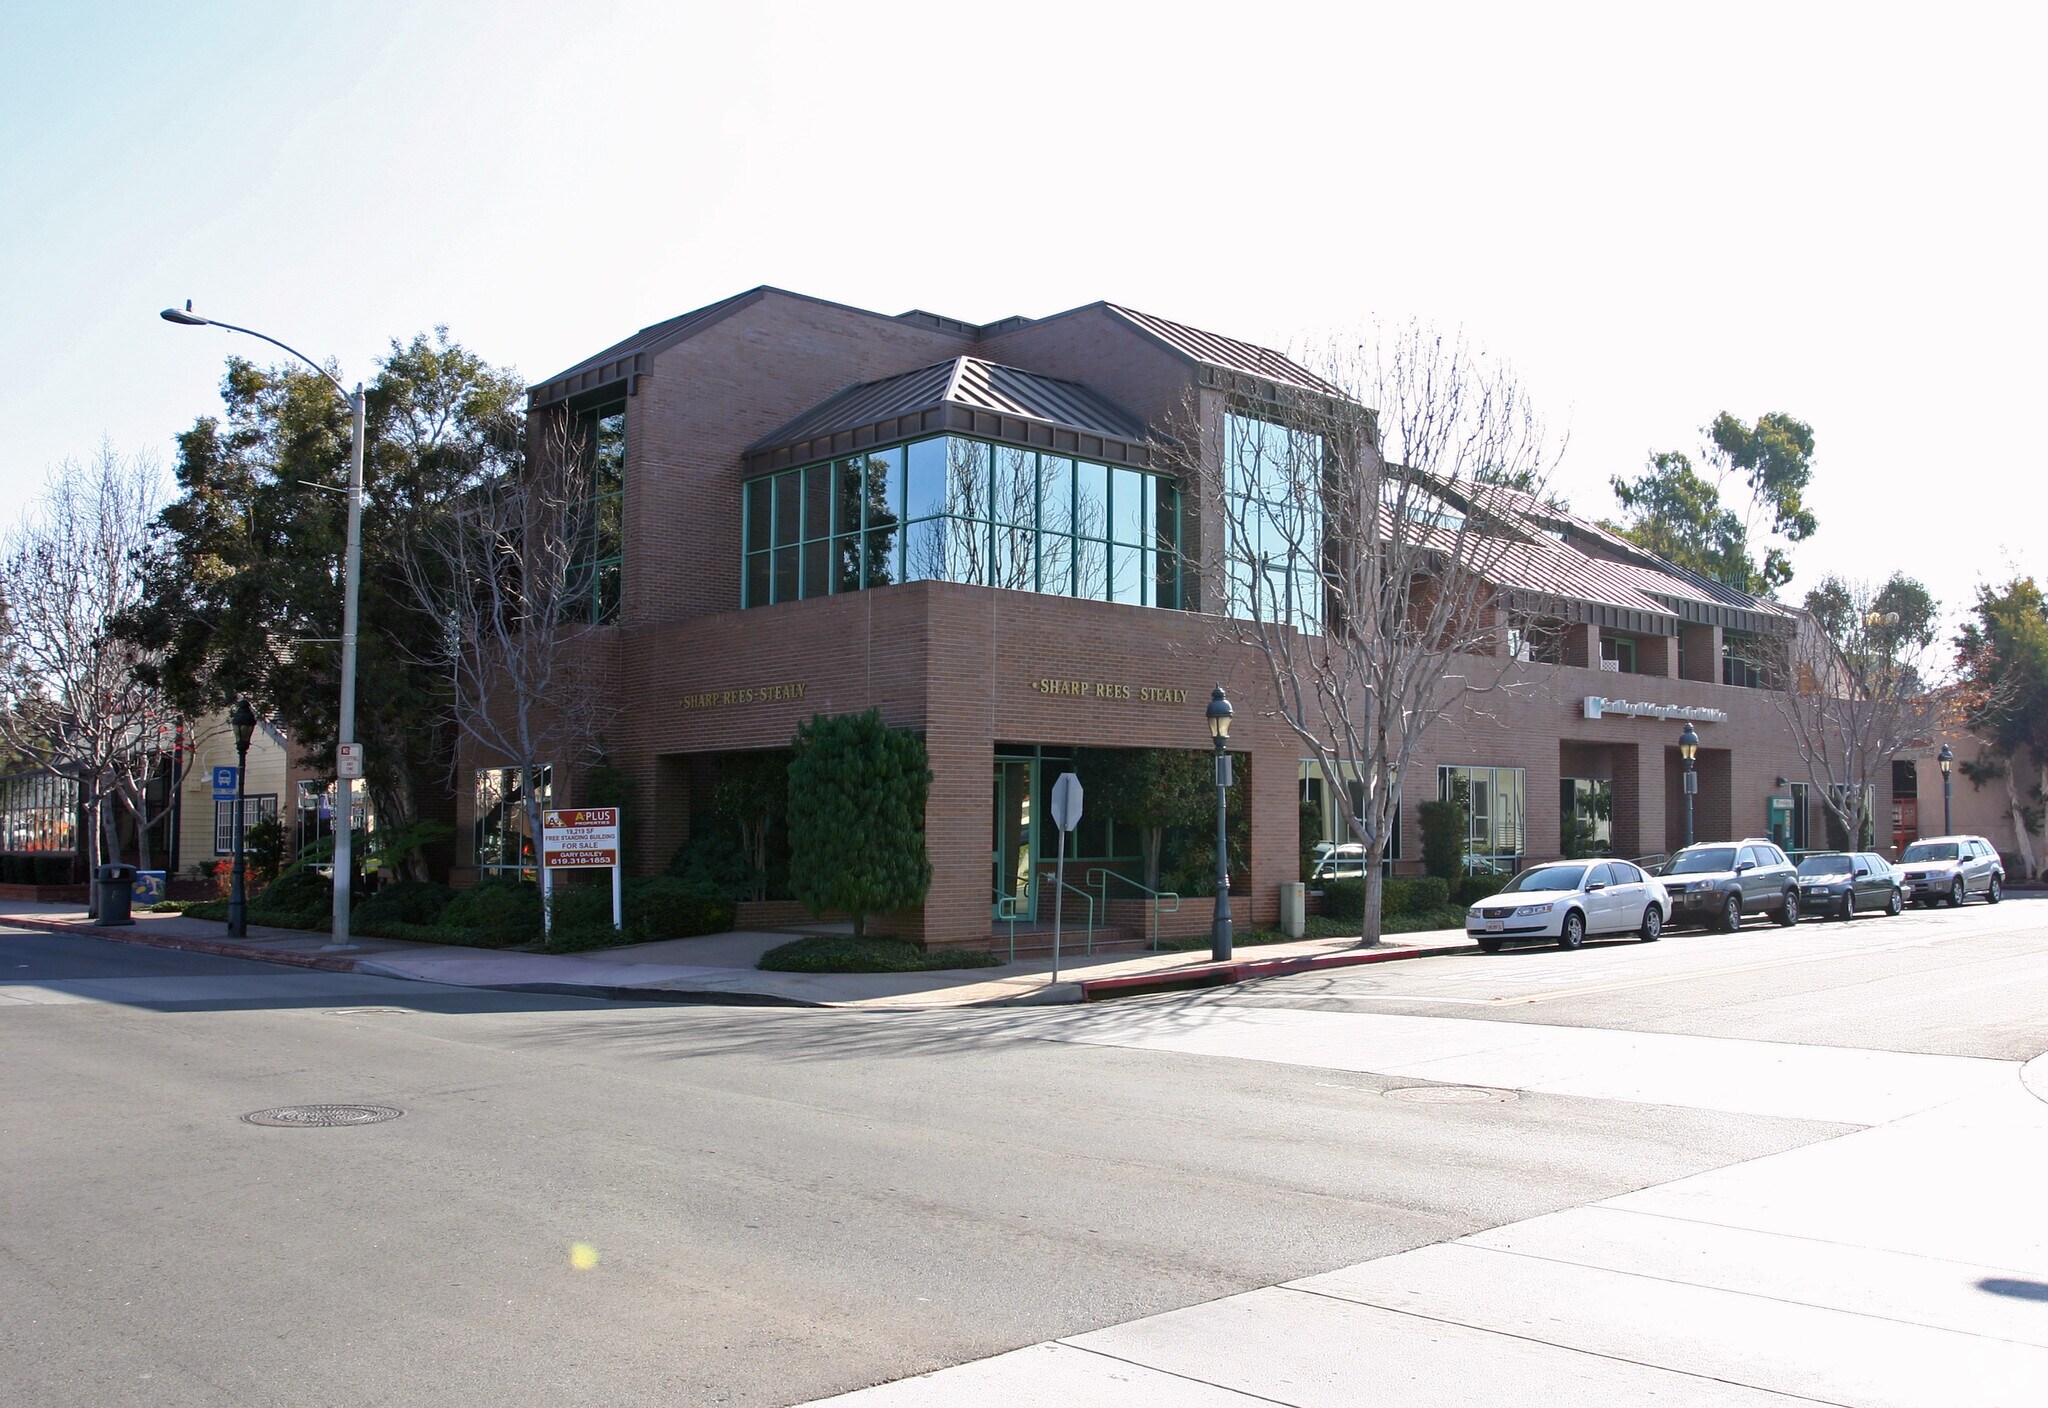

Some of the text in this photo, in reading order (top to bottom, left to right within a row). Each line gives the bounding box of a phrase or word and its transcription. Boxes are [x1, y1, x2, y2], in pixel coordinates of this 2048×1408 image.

[1040, 678, 1189, 703] SHARP REES STEALY
[683, 692, 719, 709] SHARP
[586, 811, 610, 820] PLUS
